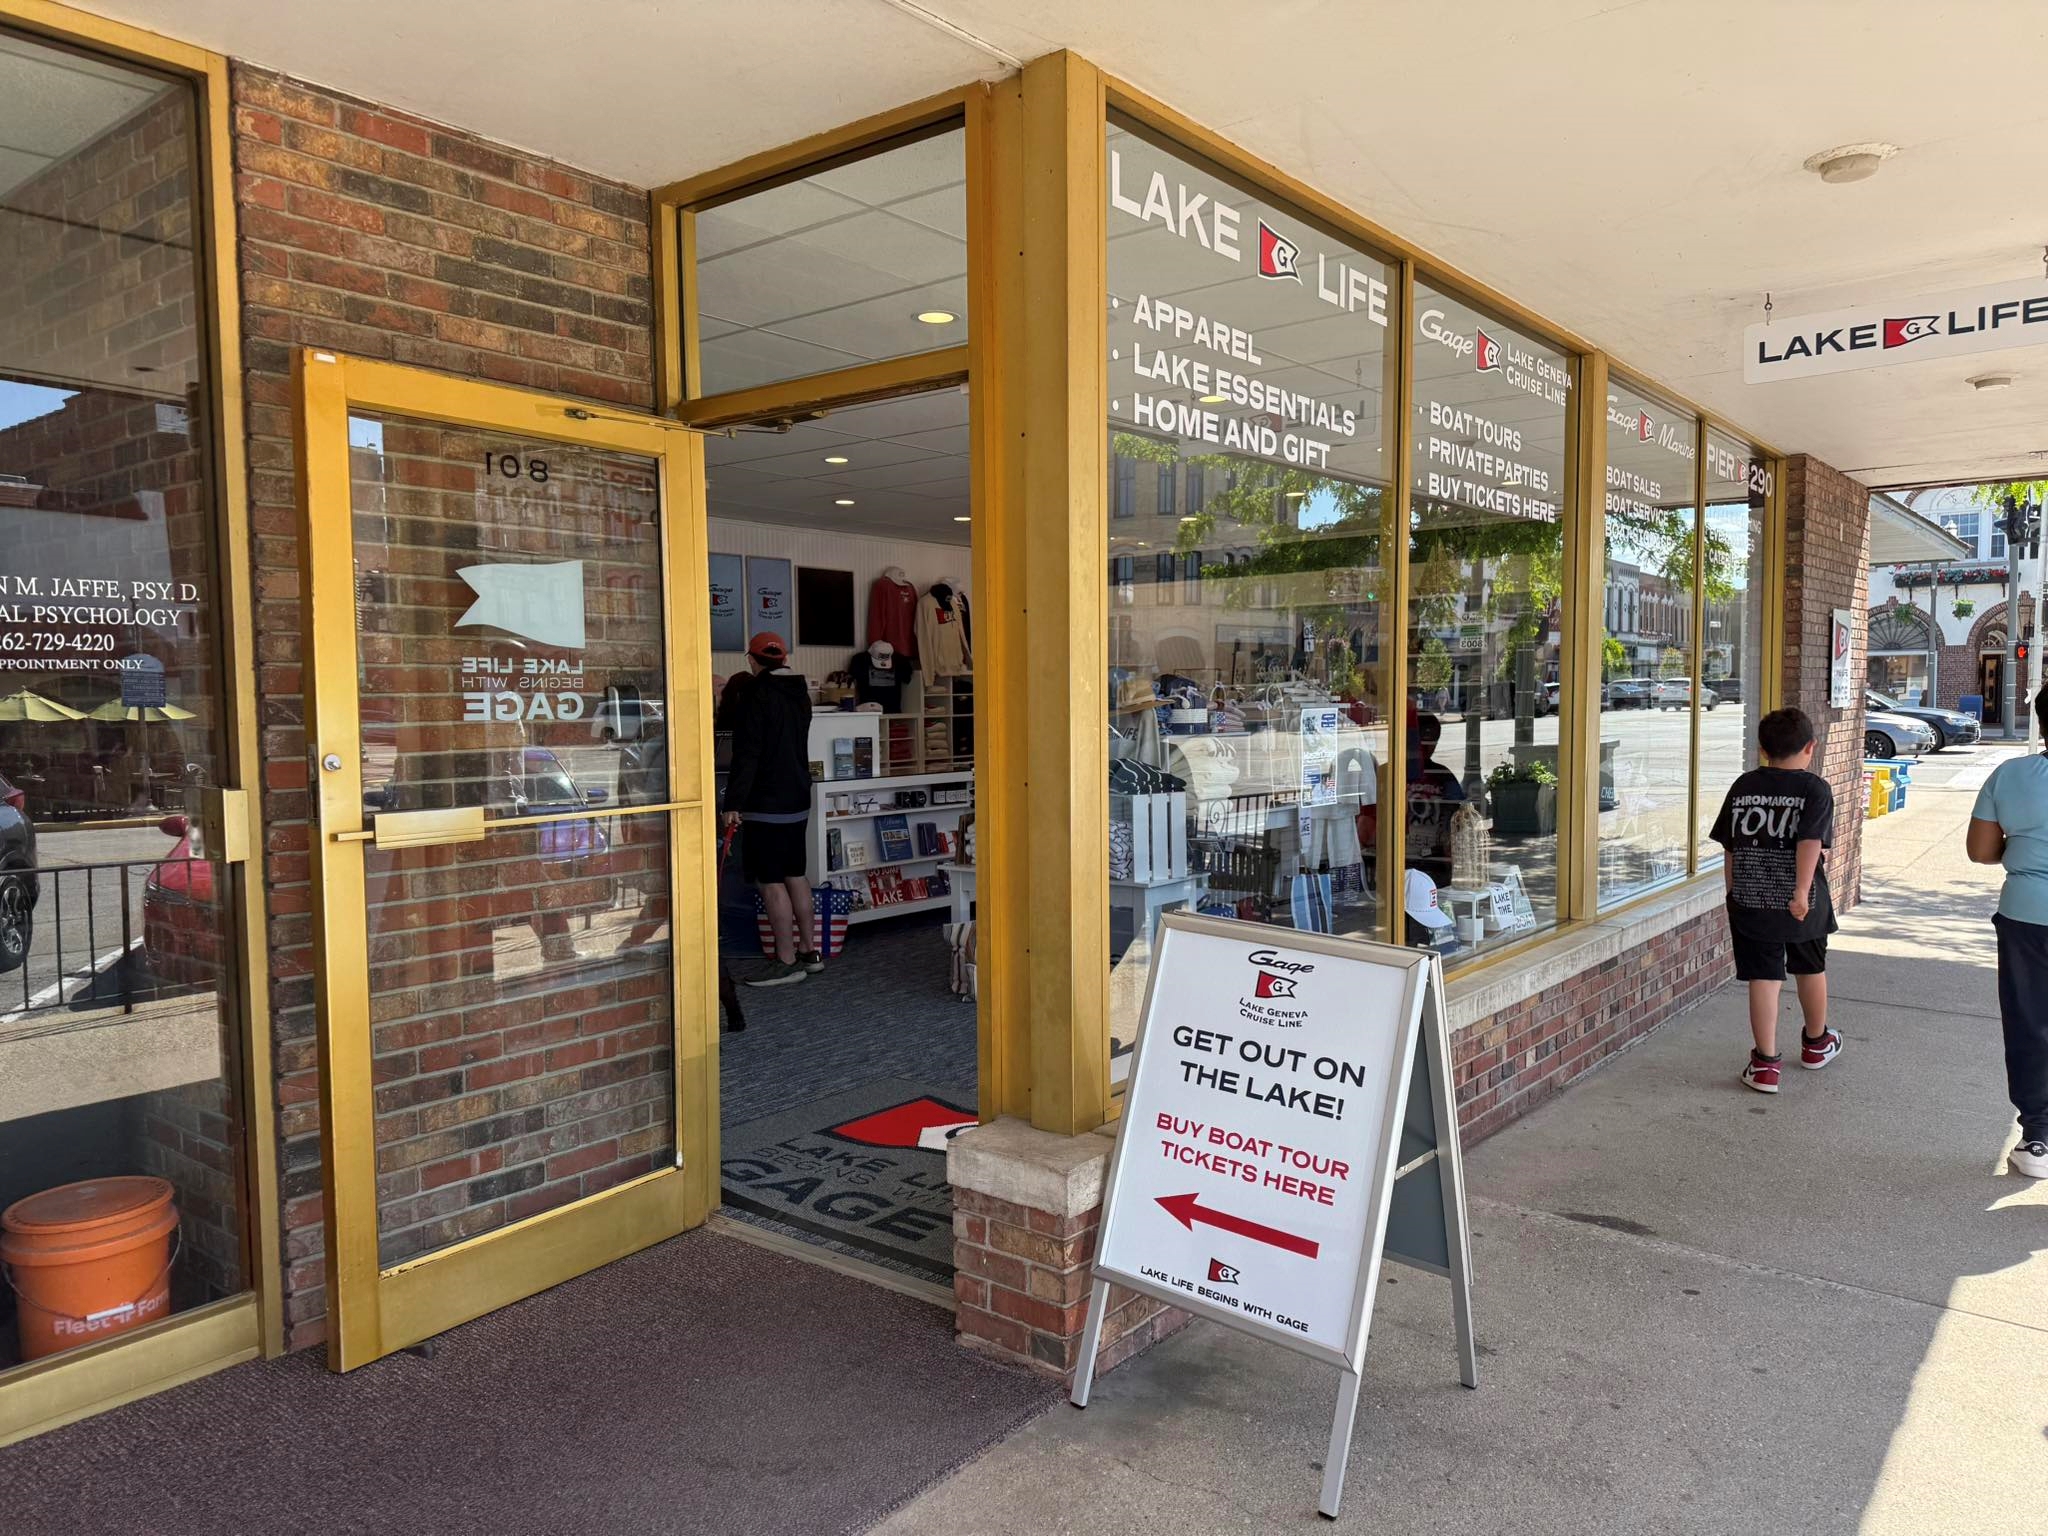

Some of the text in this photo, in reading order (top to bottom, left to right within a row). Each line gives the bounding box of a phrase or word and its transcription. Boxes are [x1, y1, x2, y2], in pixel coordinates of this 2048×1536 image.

[1112, 150, 1240, 262] LAKE
[1318, 252, 1388, 327] LIFE
[1133, 294, 1261, 366] APPAREL
[1419, 309, 1473, 358] Gage
[1759, 324, 1877, 364] LAKE
[1948, 296, 2048, 336] LIFE
[1134, 342, 1209, 394] LAKE
[1216, 369, 1356, 436] ESSENTIALS
[1506, 366, 1566, 407] CRUISE LINE
[1507, 343, 1572, 390] LAKE GENEVA
[1134, 393, 1330, 469] HOME AND GIFT
[1430, 401, 1521, 452] BOAT TOURS
[1658, 424, 1695, 460] Marine
[1429, 436, 1548, 492] PRIVATE PARTIES
[1606, 465, 1661, 499] BOAT SALES
[1706, 443, 1735, 480] PIER
[1750, 464, 1772, 497] 290
[1428, 472, 1556, 524] BUY TICKETS HERE
[1606, 493, 1669, 527] BOAT SERVICE
[14, 576, 44, 596] M.
[51, 577, 126, 601] JAFFE,
[132, 581, 175, 600] PSY.
[180, 583, 200, 601] D.
[32, 605, 181, 626] PSYCHOLOGY
[0, 632, 115, 651] 62-729-4220
[103, 659, 144, 670] ONLY
[876, 890, 904, 905] LAKE
[1248, 950, 1315, 975] Gage
[1240, 997, 1308, 1018] LAKE GENEVA
[1240, 1008, 1302, 1028] CRUISE LINE
[1173, 1025, 1366, 1088] GET OUT ON
[1180, 1060, 1345, 1121] THE LAKE!
[775, 1137, 898, 1173] LAKE
[1156, 1112, 1350, 1181] BUY BOAT TOUR
[1161, 1140, 1336, 1207] TICKETS HERE
[721, 1159, 954, 1242] GAGE
[1140, 1265, 1308, 1332] LAKE LIFE BEGINS WITH GAGE
